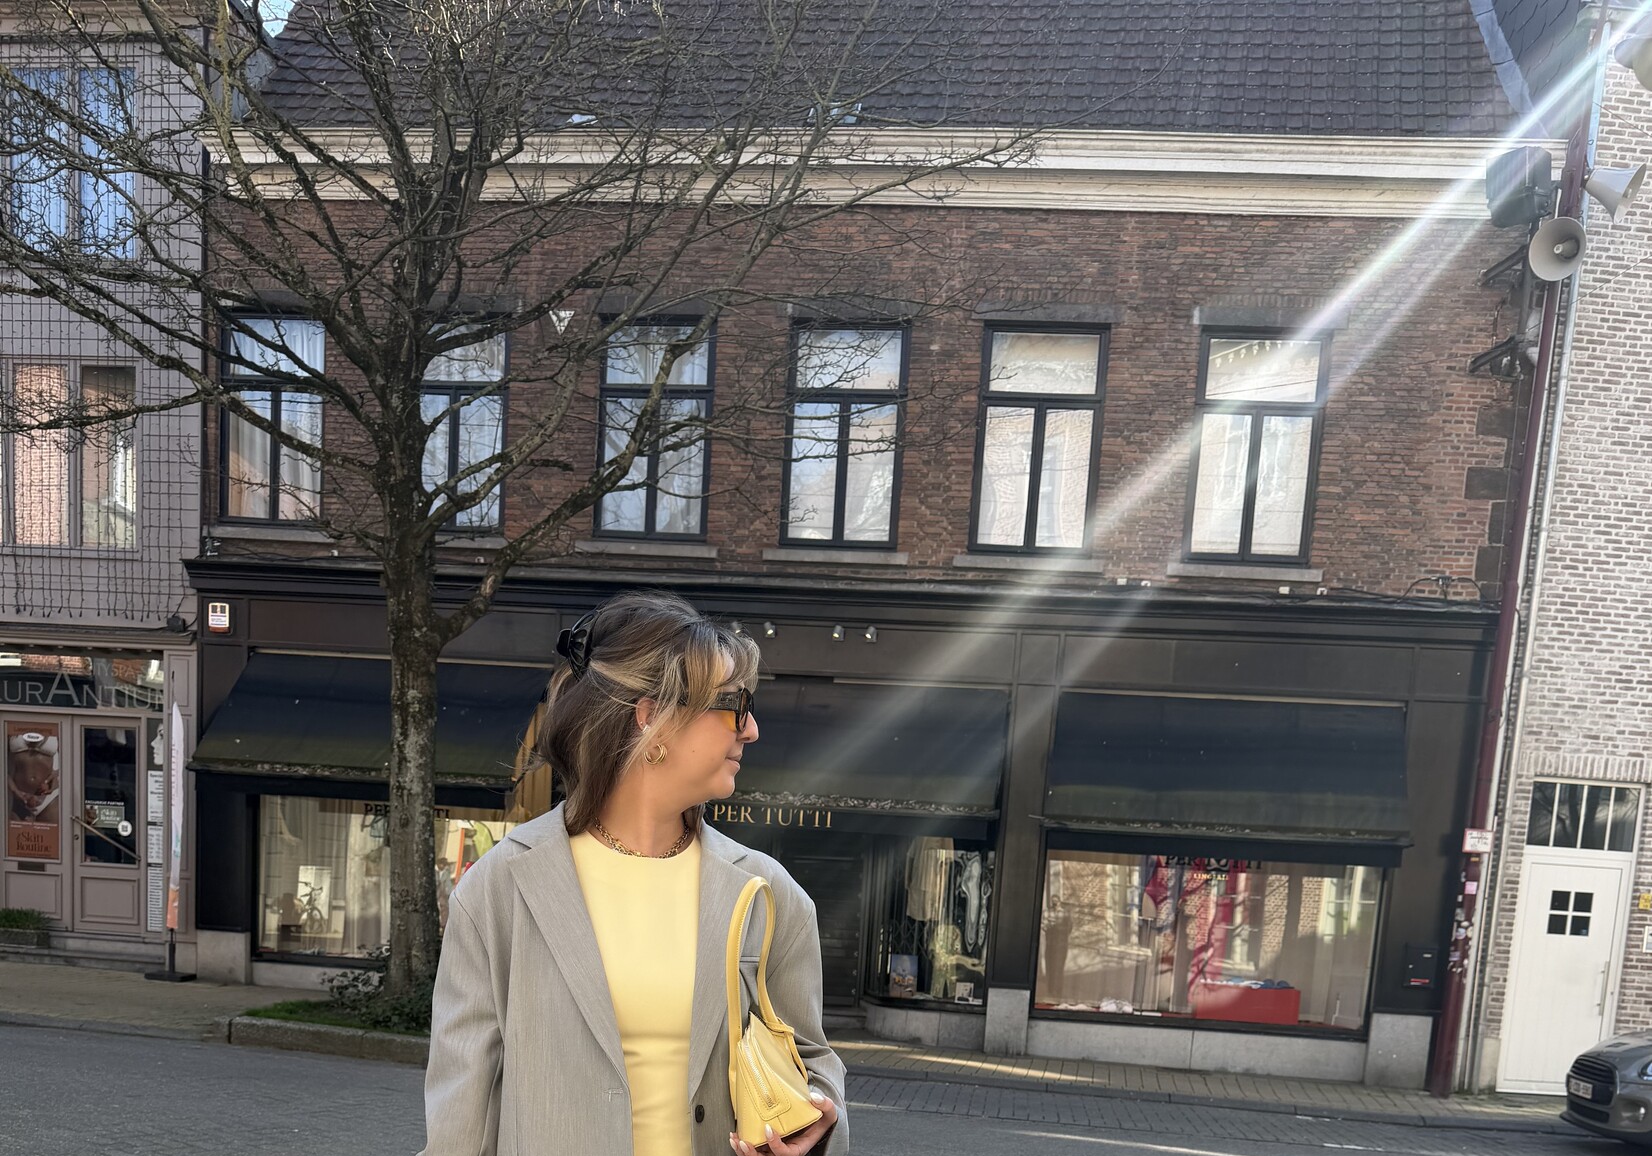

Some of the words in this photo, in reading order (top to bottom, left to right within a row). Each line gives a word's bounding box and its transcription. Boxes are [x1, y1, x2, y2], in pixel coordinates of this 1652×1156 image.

[0, 671, 163, 710] URANTIU
[713, 804, 755, 824] PER
[761, 806, 833, 828] TUTTI
